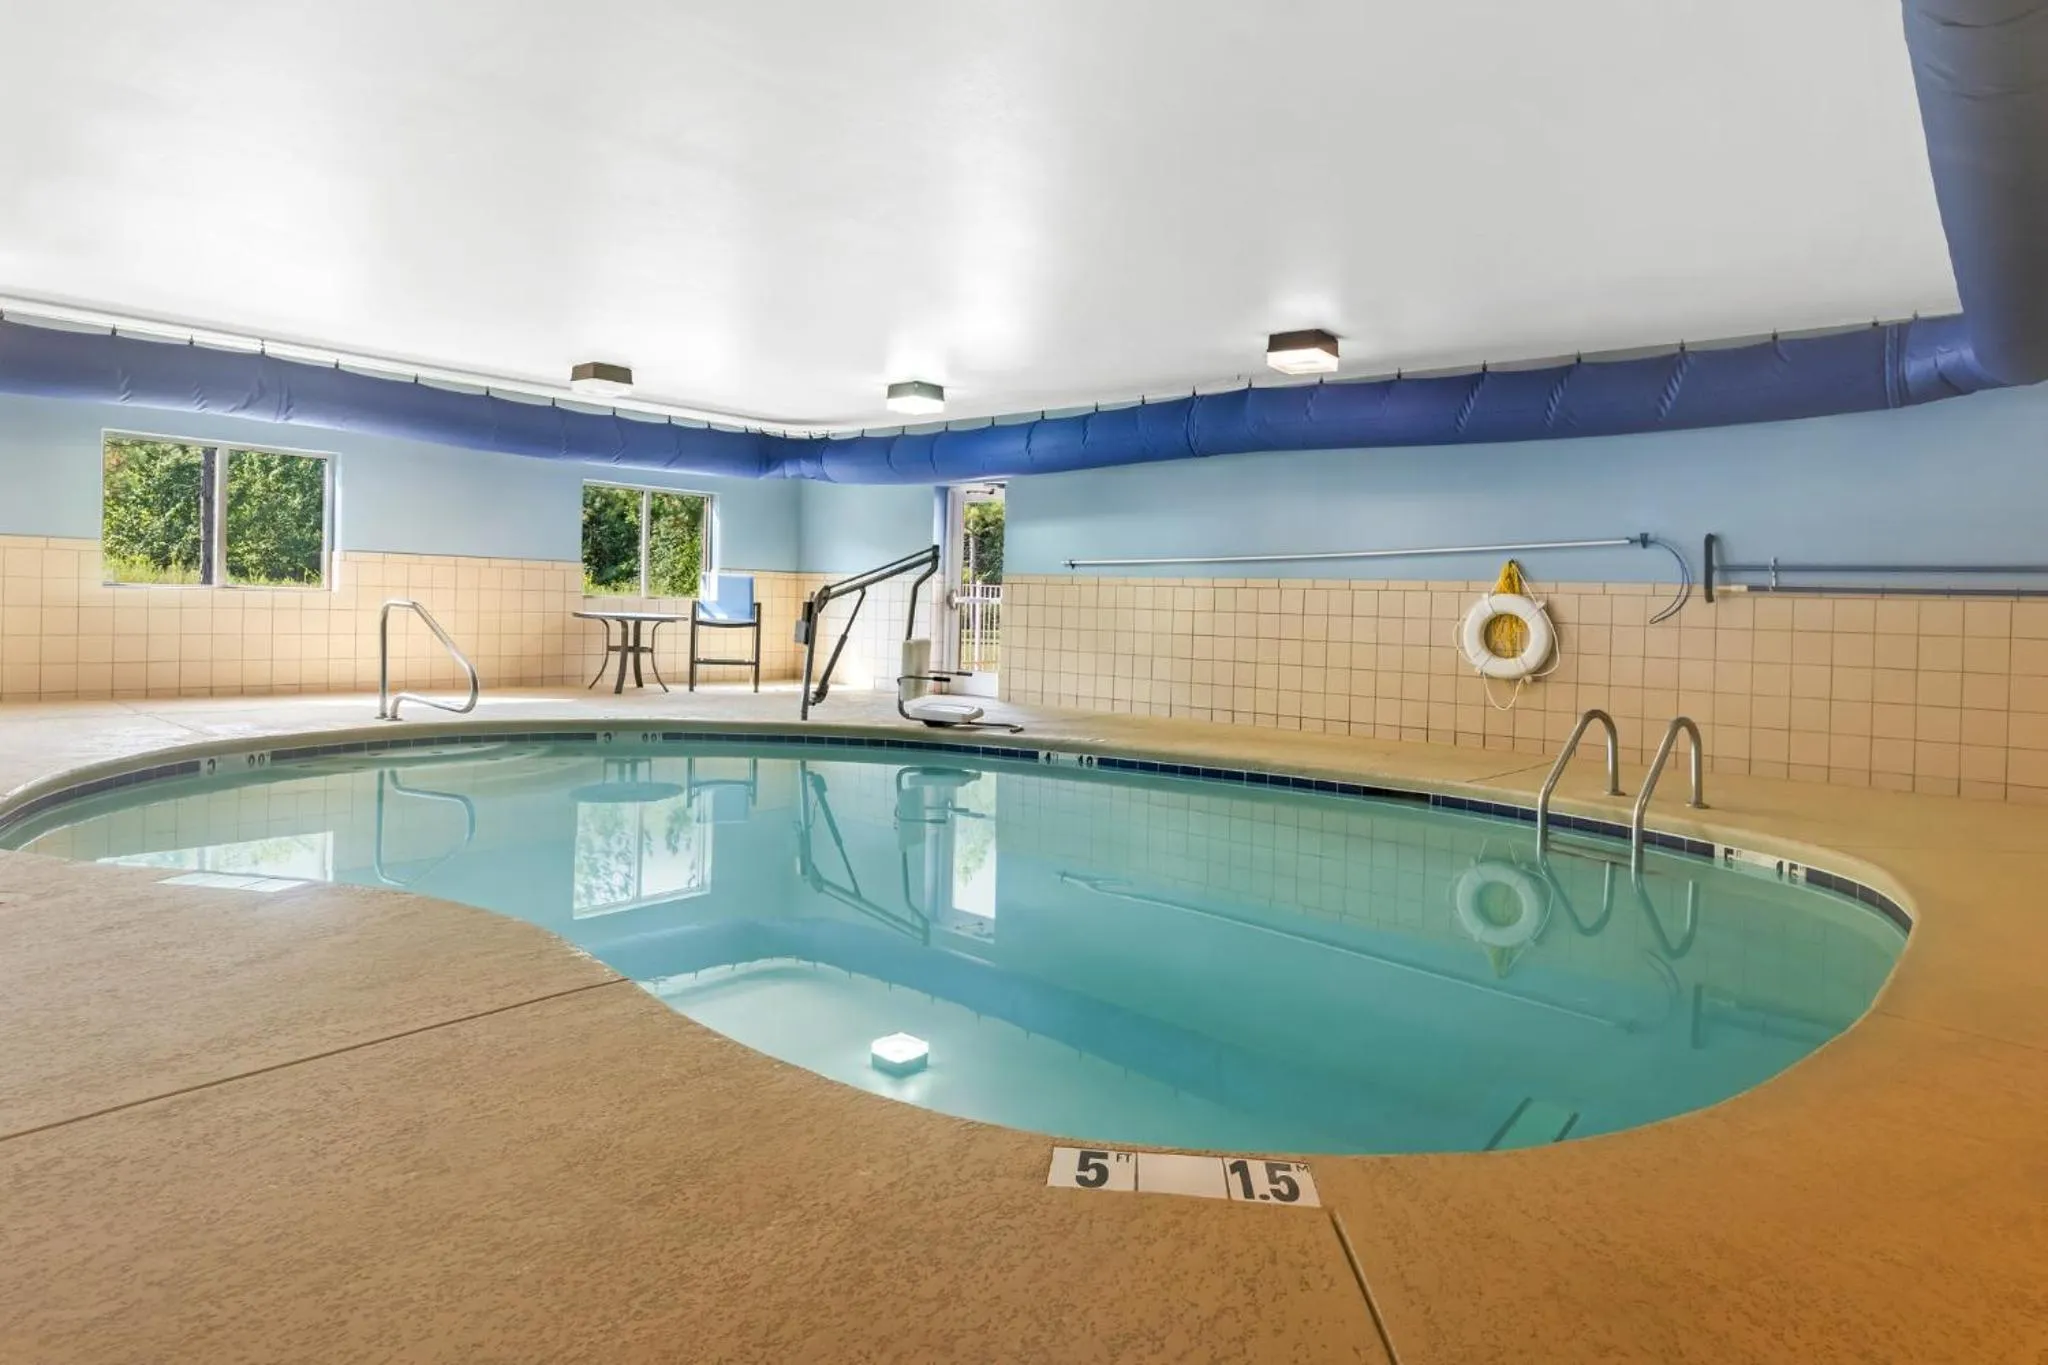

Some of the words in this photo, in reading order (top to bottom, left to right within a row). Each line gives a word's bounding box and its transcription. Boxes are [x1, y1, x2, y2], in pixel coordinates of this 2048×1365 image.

[1075, 1150, 1110, 1188] 5
[1116, 1152, 1130, 1163] FT
[1229, 1159, 1300, 1203] 1.5
